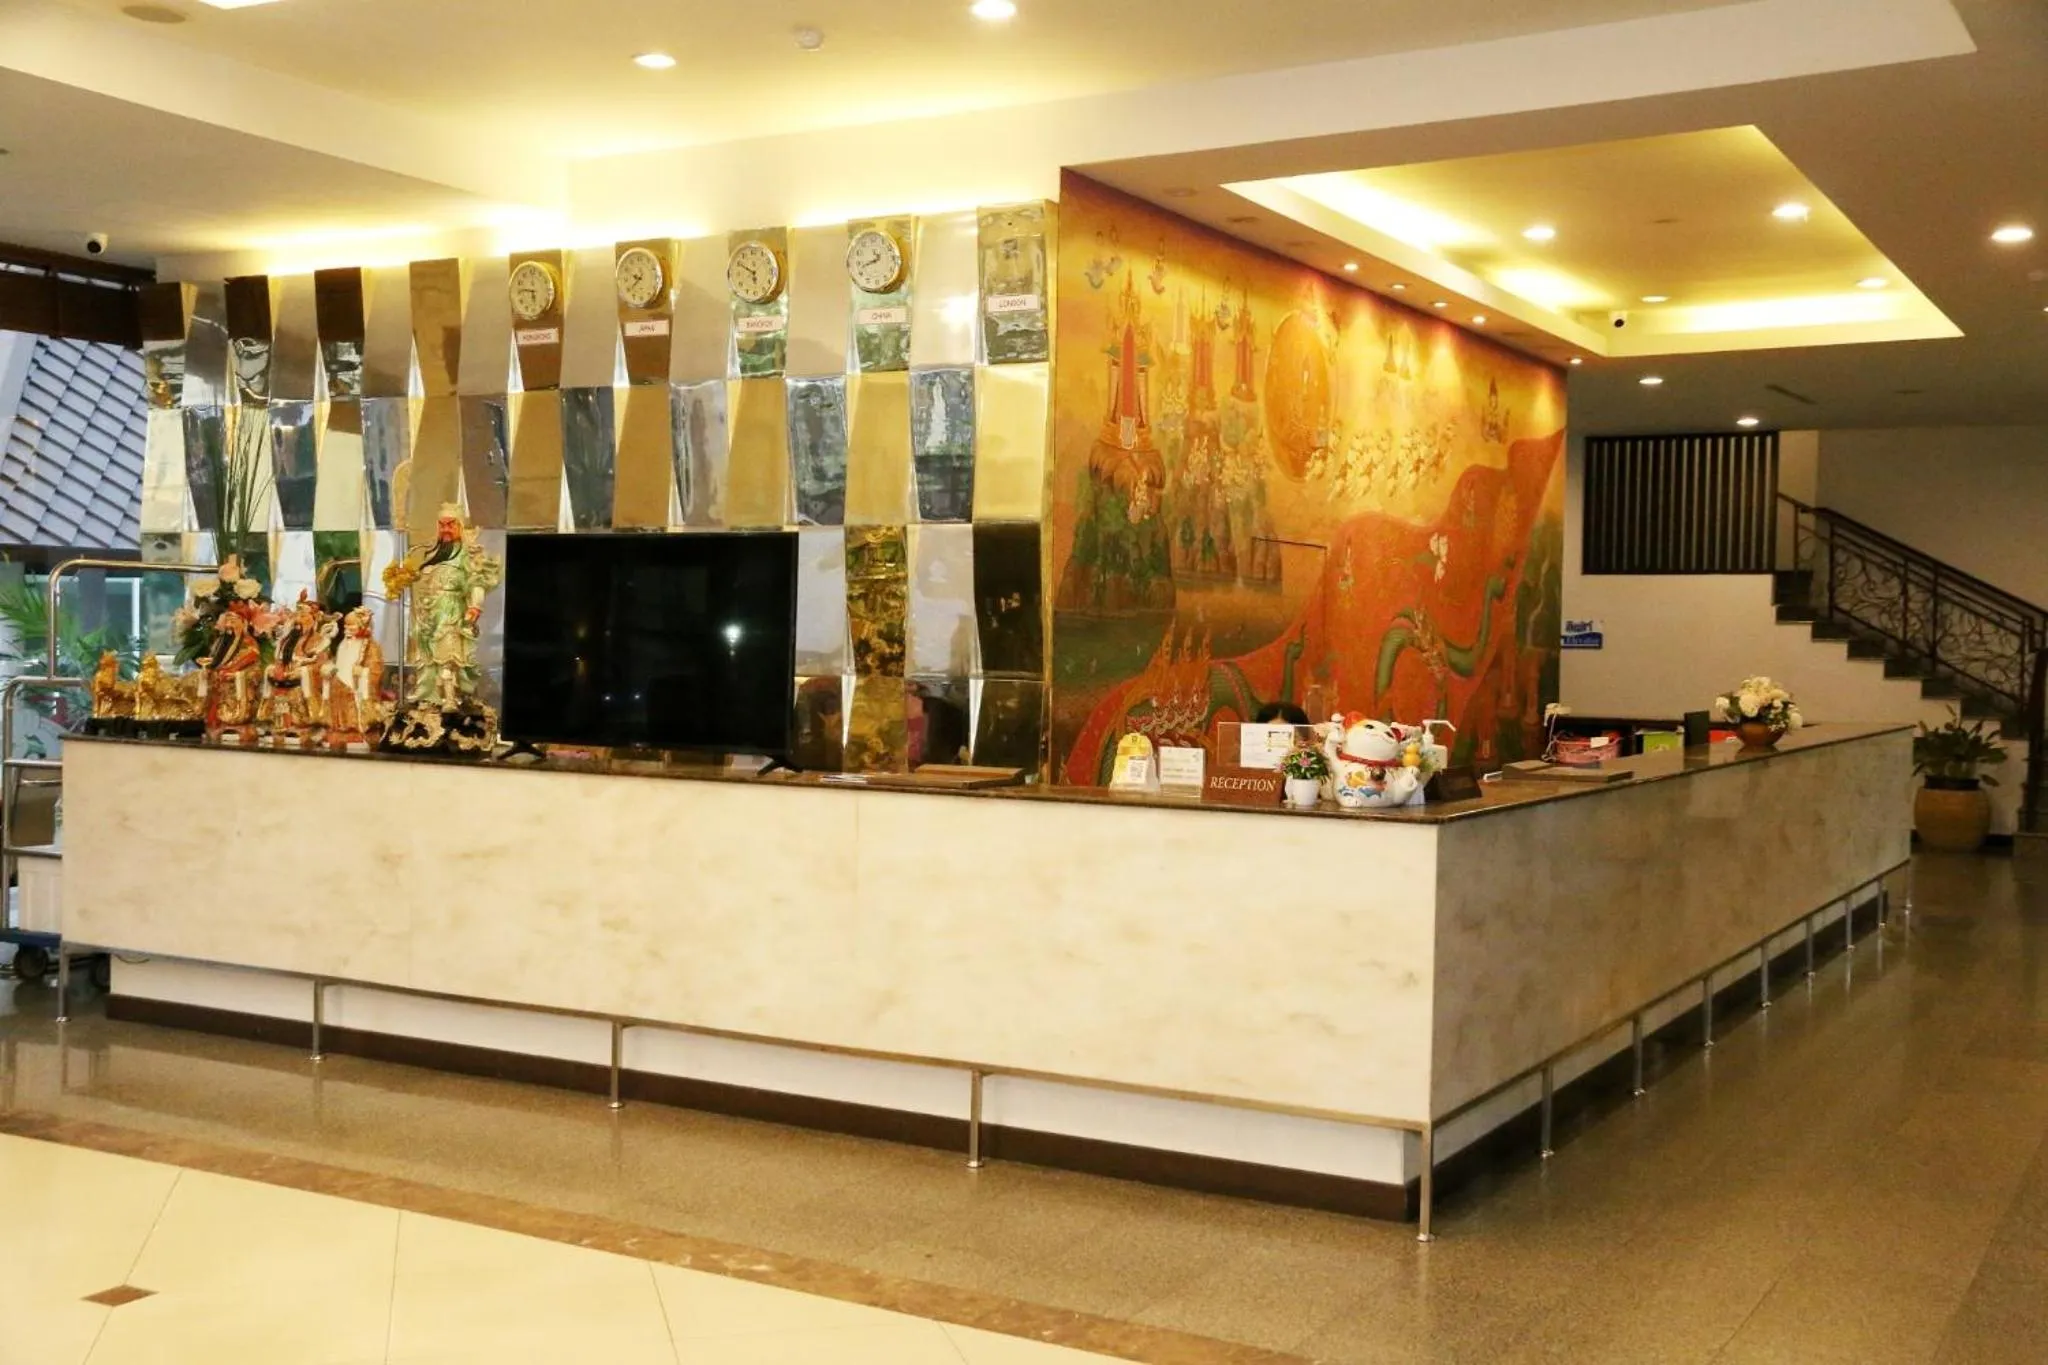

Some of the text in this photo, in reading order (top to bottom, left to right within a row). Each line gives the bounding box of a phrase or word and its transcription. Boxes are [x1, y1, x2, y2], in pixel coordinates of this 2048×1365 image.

[998, 298, 1026, 308] LONDON
[871, 311, 893, 320] CHINA
[1209, 776, 1277, 793] RECEPTION
